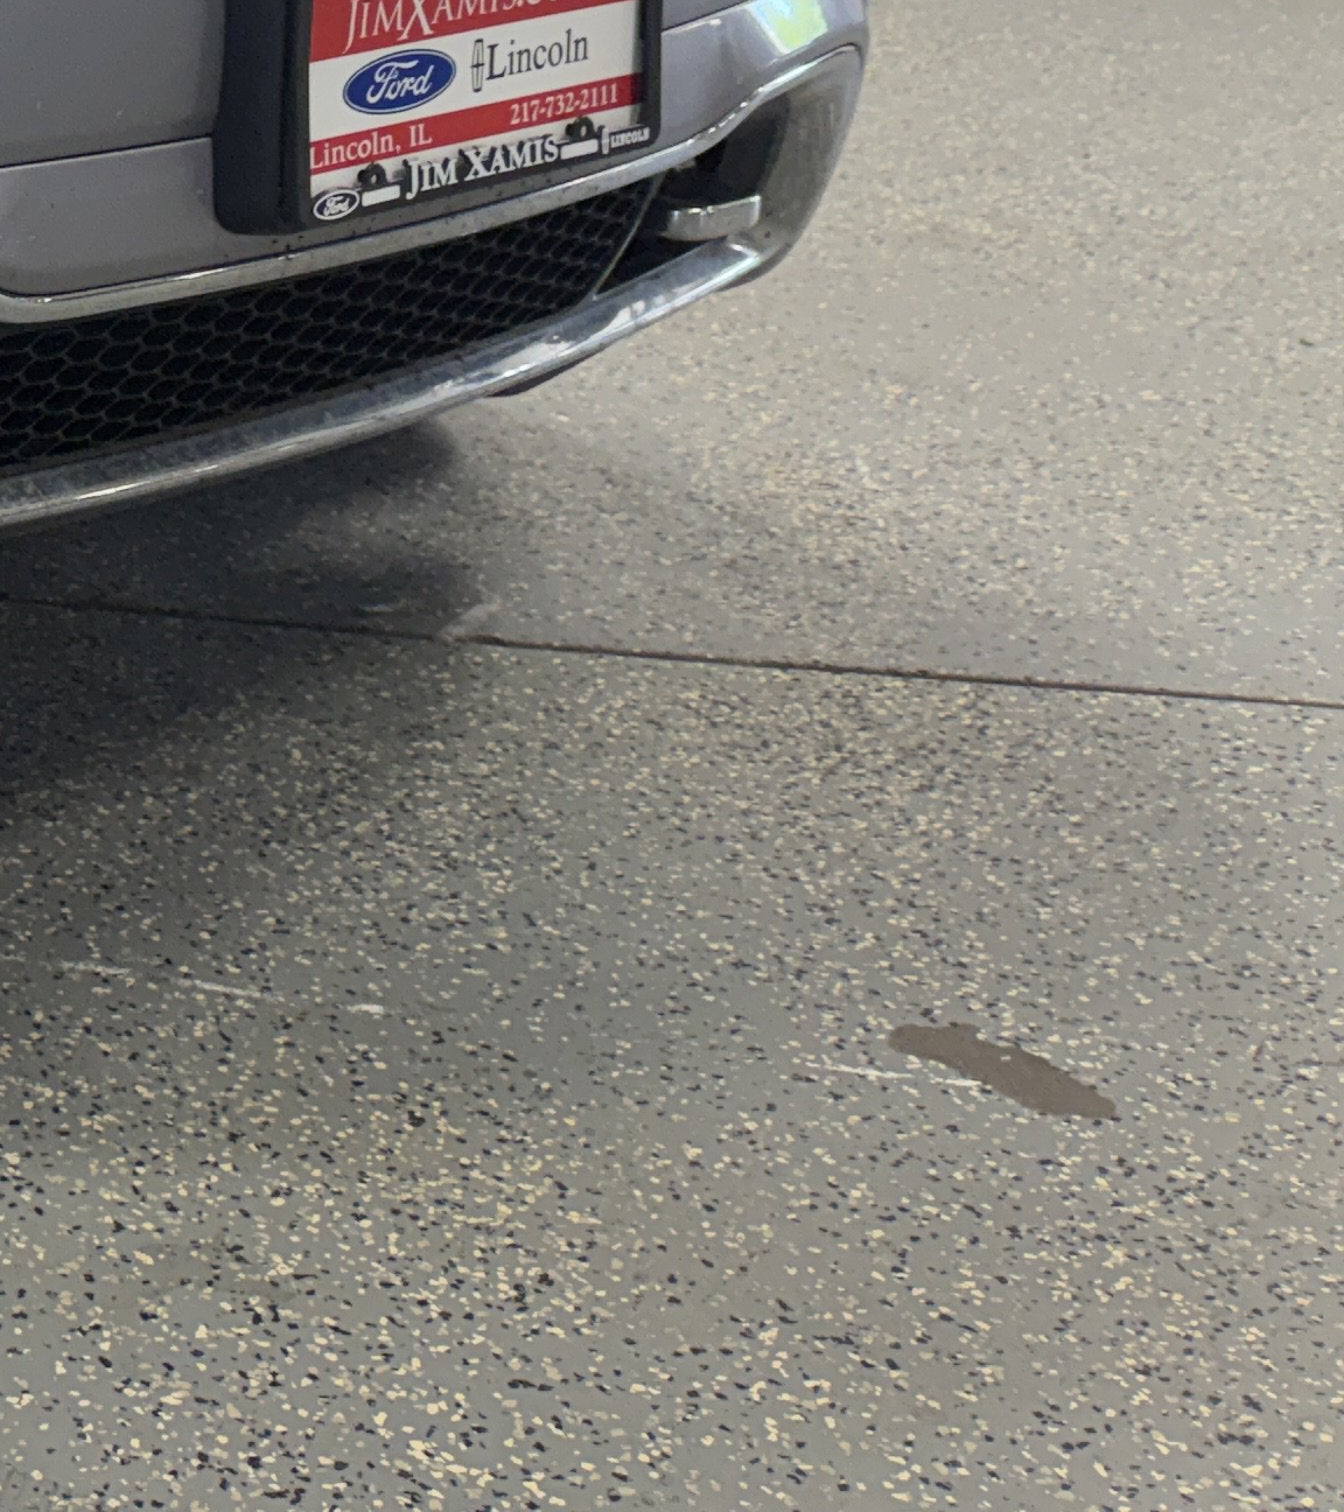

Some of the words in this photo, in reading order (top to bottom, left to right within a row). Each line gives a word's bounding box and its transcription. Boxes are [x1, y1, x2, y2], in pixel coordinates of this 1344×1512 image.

[486, 27, 590, 81] Lincoln
[365, 59, 434, 105] Ford
[510, 82, 619, 126] 217-732-2111
[310, 130, 402, 170] Lincoln,
[408, 124, 433, 147] IL
[405, 157, 459, 201] JIM
[463, 136, 561, 183] XAMIS
[322, 193, 353, 218] Ford
